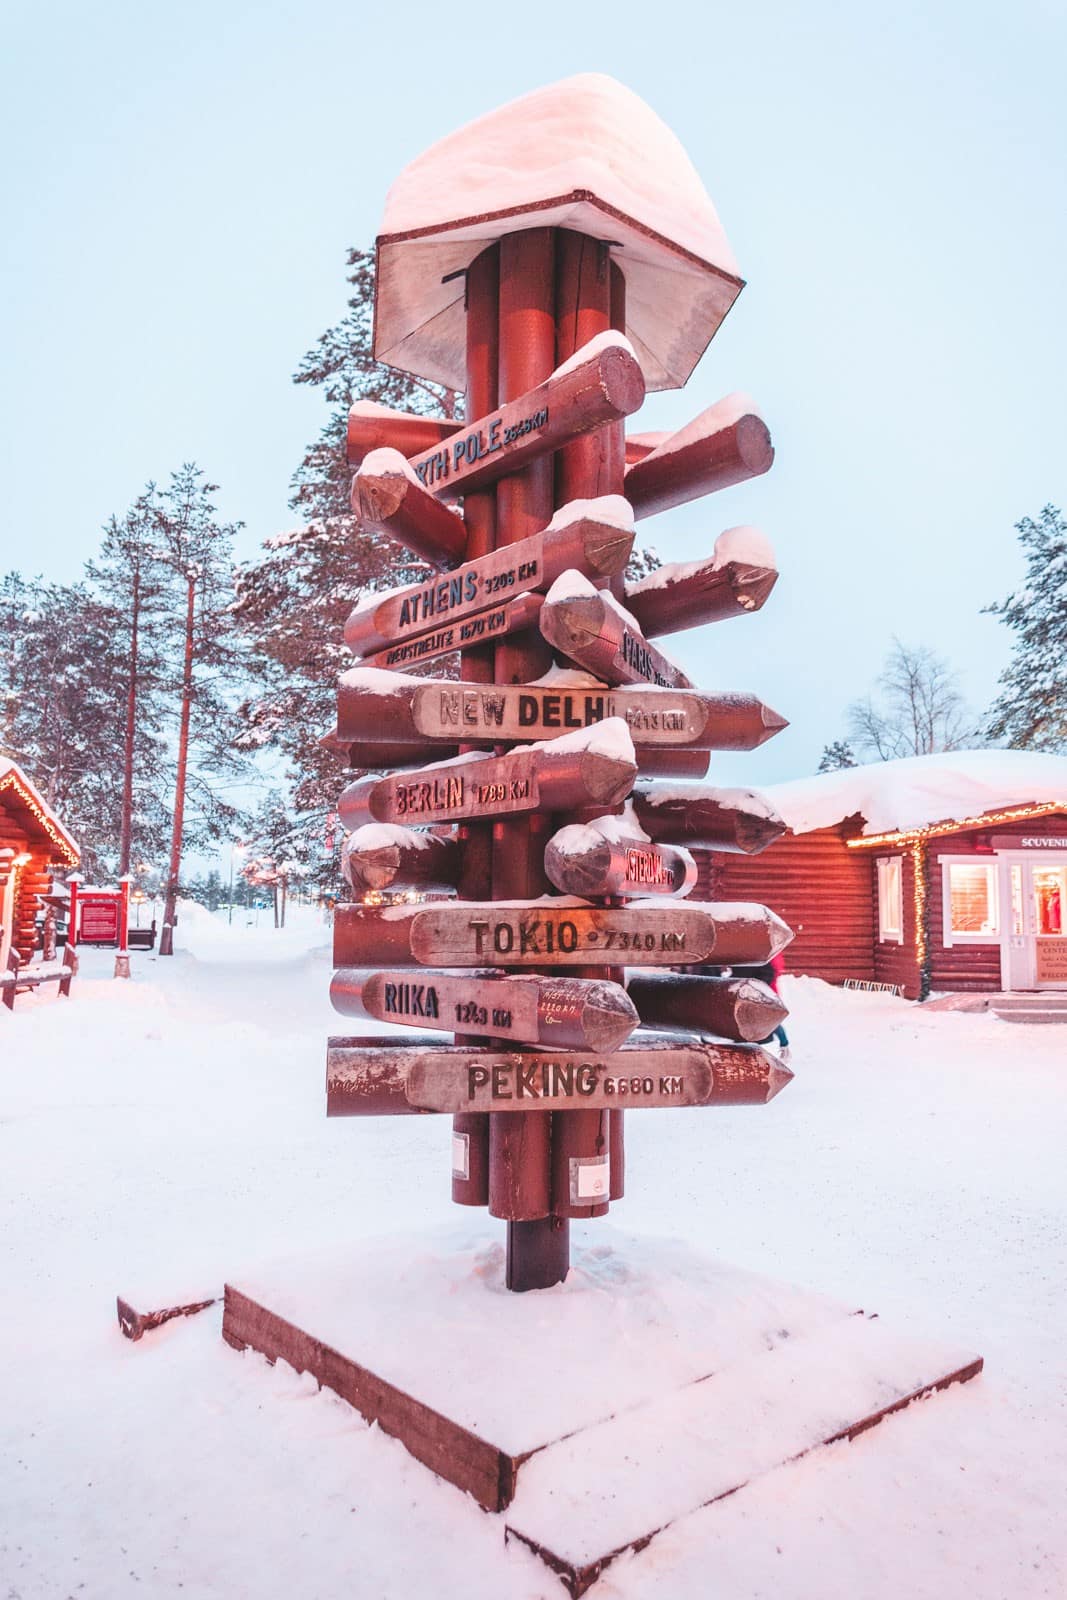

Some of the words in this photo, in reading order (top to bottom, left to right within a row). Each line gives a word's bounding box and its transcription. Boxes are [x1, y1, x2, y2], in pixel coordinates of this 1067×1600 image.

[415, 449, 448, 487] RTH
[453, 419, 502, 471] POLE
[399, 571, 477, 627] ATHENS
[518, 560, 538, 582] KM
[488, 611, 506, 631] KM
[622, 631, 654, 681] PARIS
[440, 690, 505, 725] NEW
[662, 709, 686, 730] KM
[396, 777, 465, 815] BERLIN
[509, 779, 529, 800] KM
[1022, 838, 1067, 847] SOUVENI
[469, 920, 578, 954] TOKIO
[604, 931, 655, 951] 7340
[660, 933, 686, 952] KM
[384, 982, 439, 1019] RIIKA
[492, 1008, 512, 1028] KM
[467, 1063, 598, 1100] PEKING
[603, 1077, 653, 1095] 6680
[659, 1077, 684, 1095] KM
